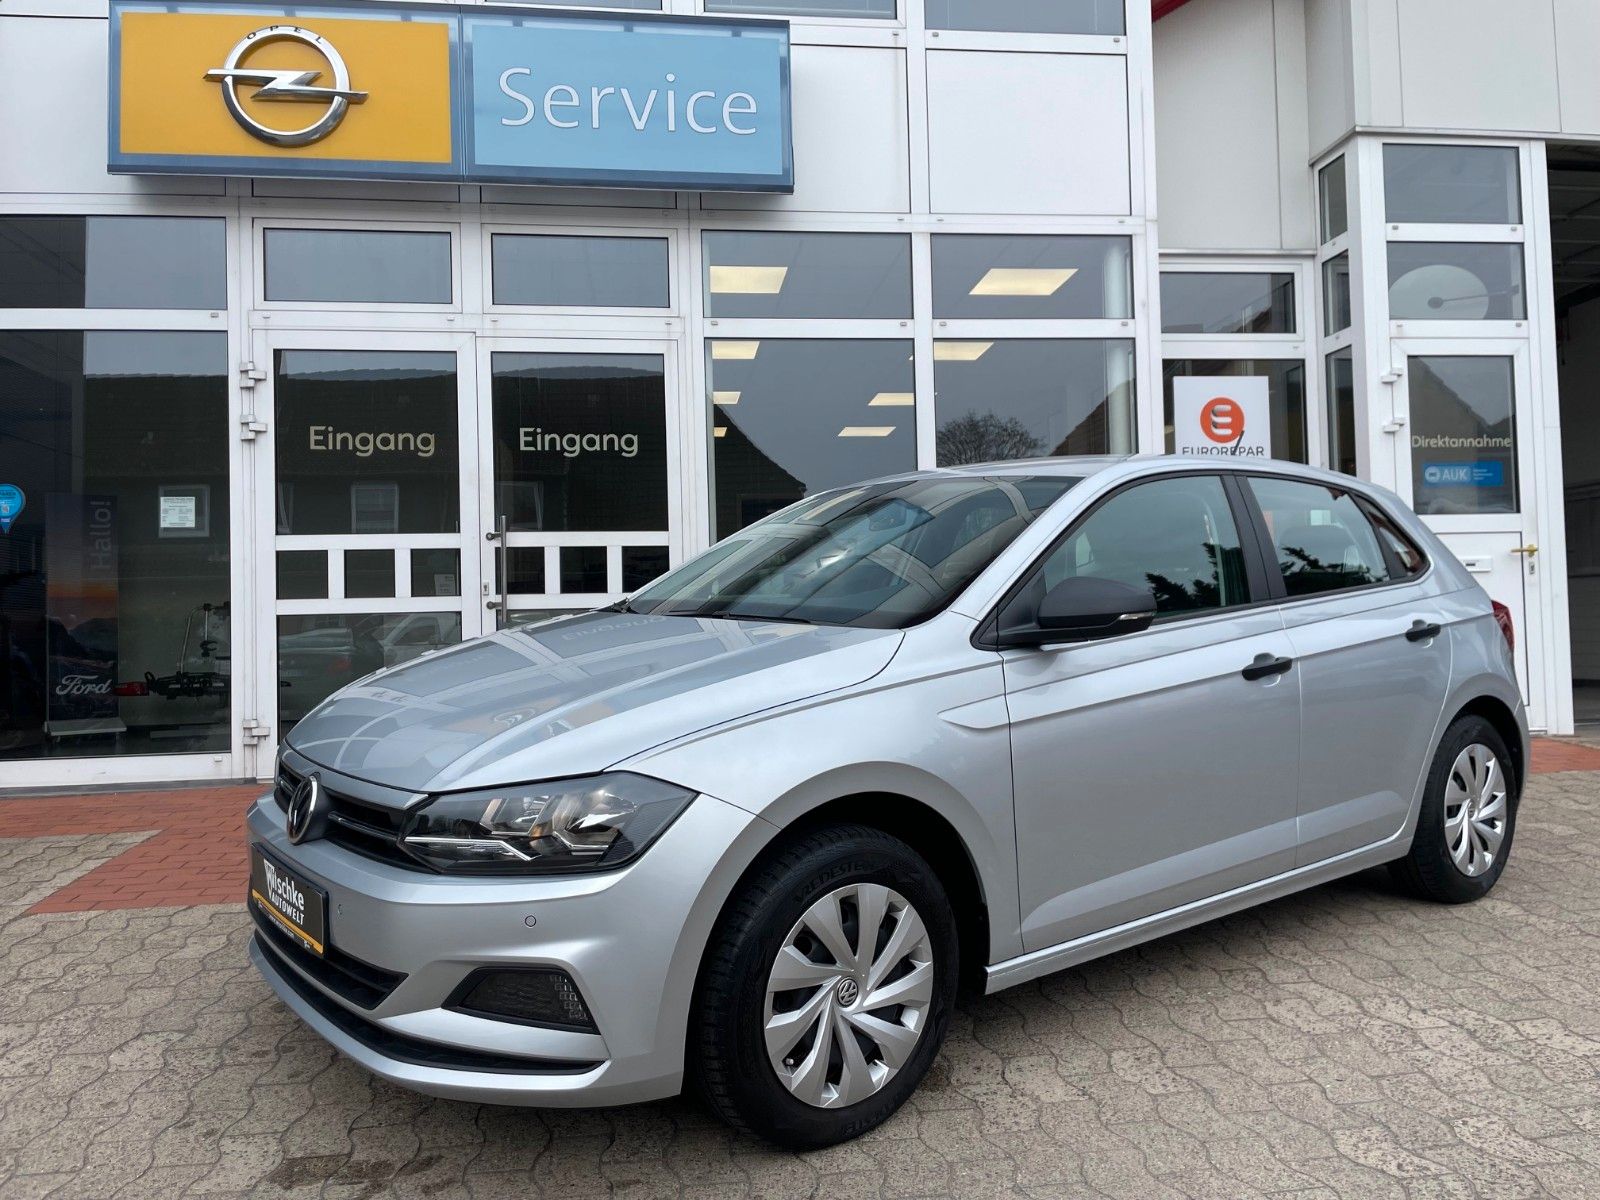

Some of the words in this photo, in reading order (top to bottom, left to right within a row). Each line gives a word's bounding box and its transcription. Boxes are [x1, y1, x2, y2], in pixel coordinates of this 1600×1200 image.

[246, 25, 322, 44] OPEL
[499, 67, 757, 134] Service
[309, 426, 436, 457] Eingang
[519, 427, 639, 458] Eingang
[1182, 446, 1264, 456] EUROREPAR
[1411, 434, 1512, 448] Direktannahme
[89, 501, 112, 569] Hallo!
[56, 674, 112, 695] Ford
[272, 891, 305, 925] AUTOWELT
